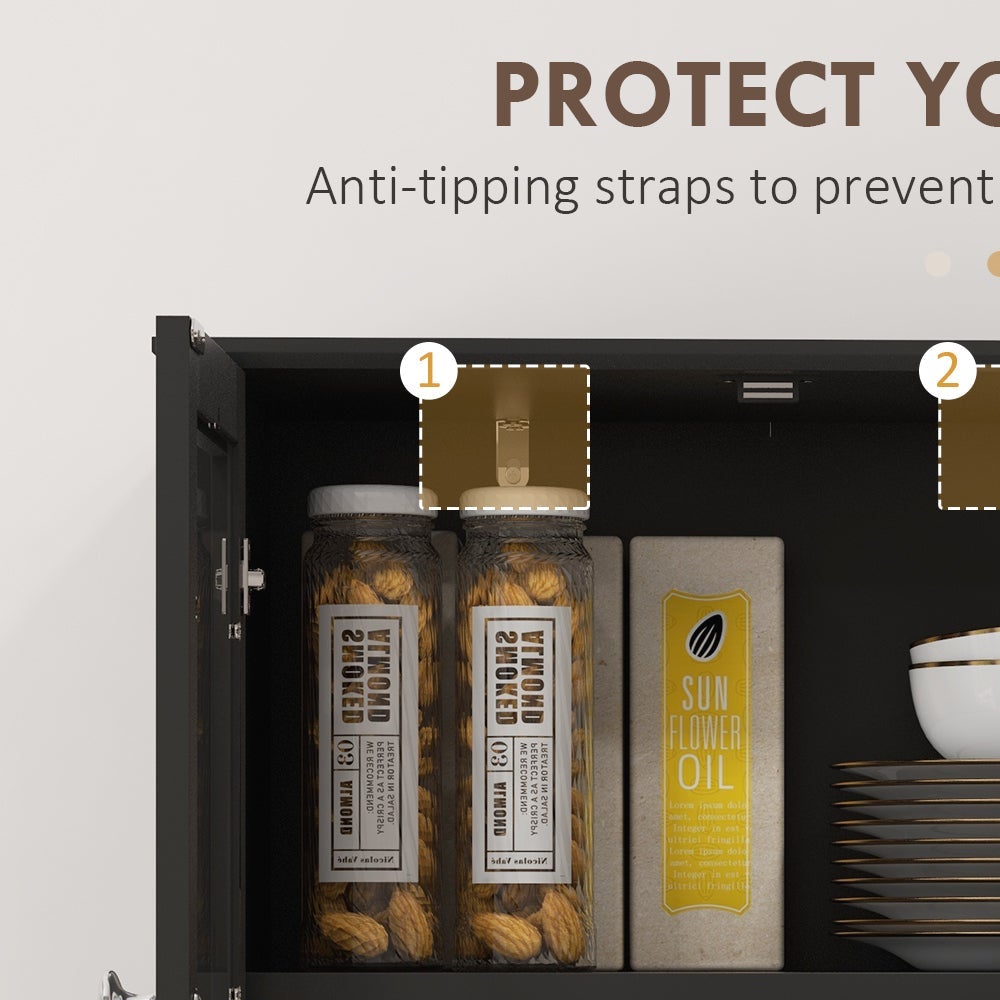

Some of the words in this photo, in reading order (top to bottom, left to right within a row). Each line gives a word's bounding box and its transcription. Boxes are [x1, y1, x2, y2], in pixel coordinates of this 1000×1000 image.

[682, 675, 728, 711] SUN
[669, 715, 741, 750] FLOWER
[678, 754, 734, 790] OIL
